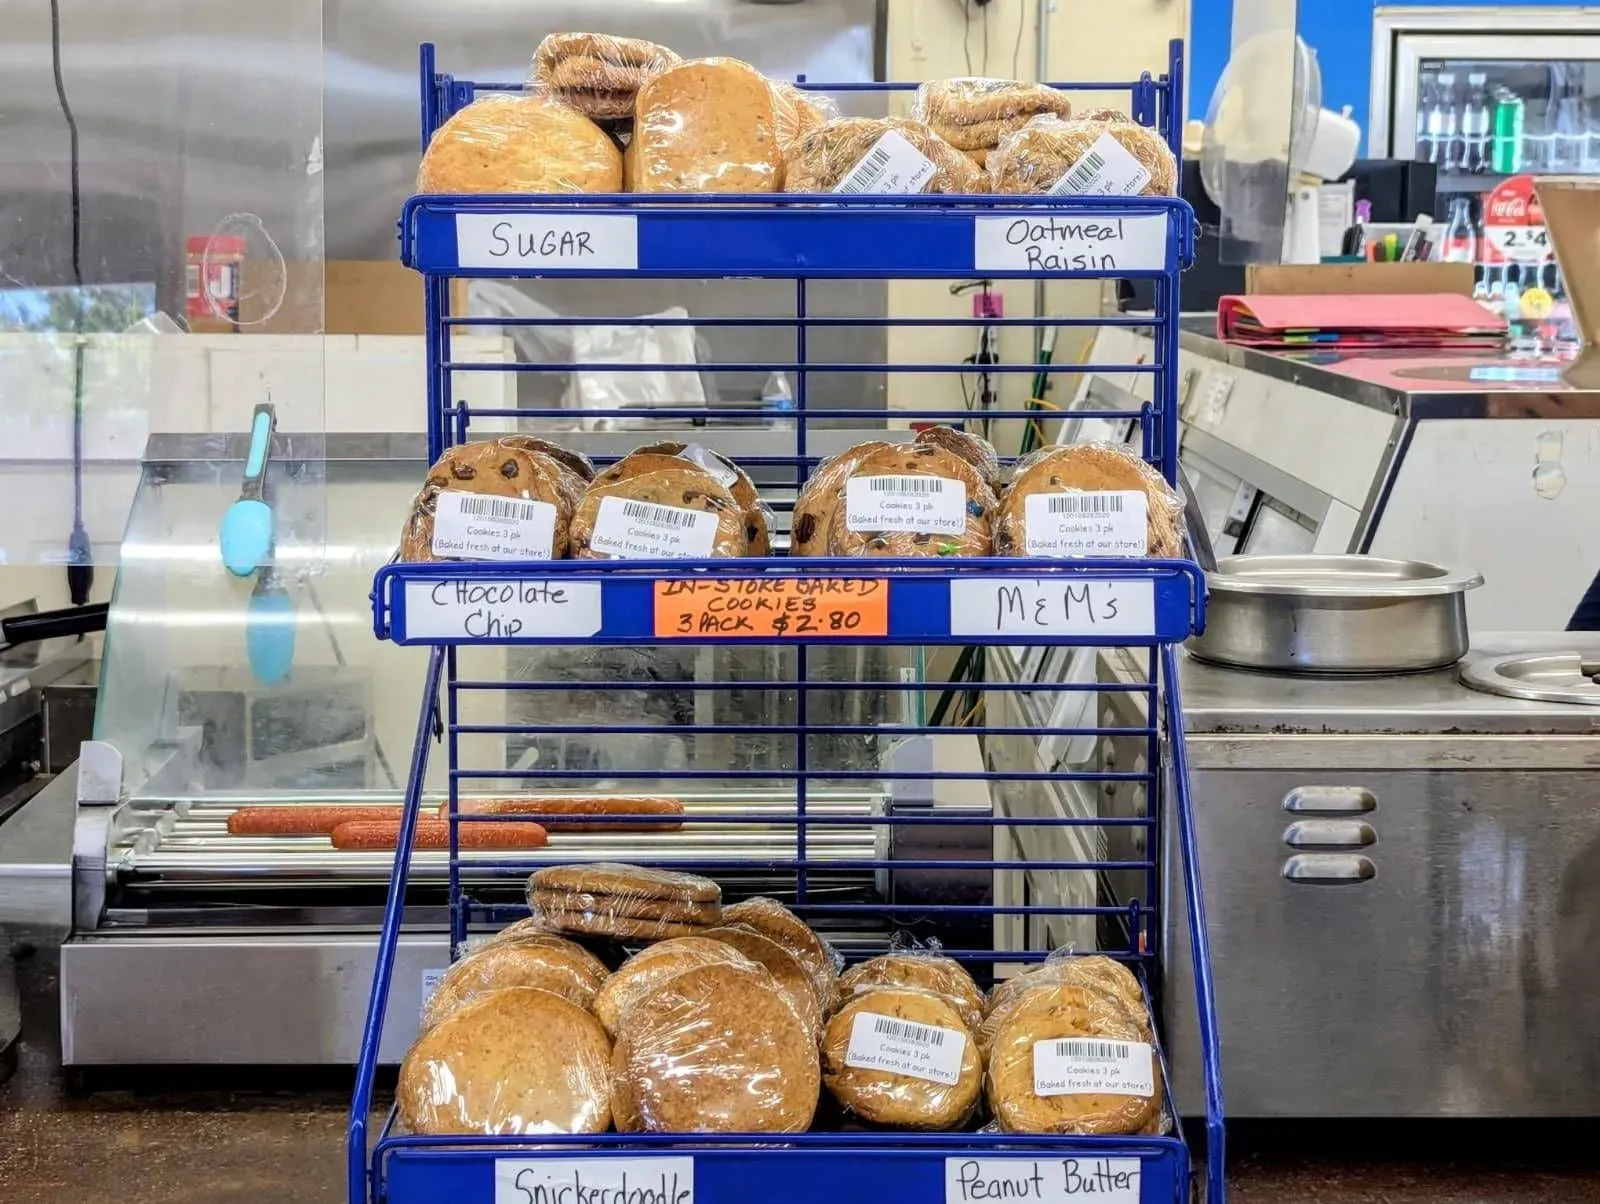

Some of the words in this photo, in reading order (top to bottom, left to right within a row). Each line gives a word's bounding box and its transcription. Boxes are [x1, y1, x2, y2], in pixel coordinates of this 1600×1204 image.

[488, 222, 595, 257] SUGAR
[1006, 218, 1123, 245] Oatmeal
[1503, 231, 1516, 247] 2
[1025, 246, 1116, 271] Raisin
[879, 501, 913, 510] Cookies
[923, 502, 934, 512] pk
[848, 514, 878, 524] (Baked
[880, 515, 904, 524] fresh
[906, 516, 914, 524] at
[934, 517, 964, 527] store!)
[467, 526, 500, 536] Cookies
[510, 529, 521, 540] pk
[627, 528, 660, 540] Cookies
[670, 535, 681, 544] pk
[1059, 524, 1093, 533] Cookies
[1103, 524, 1114, 535] pk
[434, 538, 464, 550] (Baked
[466, 541, 489, 552] fresh
[492, 545, 500, 553] at
[520, 548, 550, 558] store!)
[1028, 540, 1057, 549] (Baked
[1060, 540, 1083, 549] fresh
[1085, 540, 1094, 549] at
[1114, 540, 1145, 550] store!)
[707, 598, 817, 613] COOKIES
[464, 609, 523, 638] Chip
[677, 614, 693, 633] 3
[700, 613, 754, 632] PACK
[772, 611, 861, 635] $2.80
[879, 1043, 911, 1057] Cookies
[920, 1050, 931, 1063] pk
[848, 1051, 875, 1063] (Baked
[878, 1055, 900, 1069] fresh
[901, 1061, 911, 1070] at
[912, 1065, 927, 1074] our
[928, 1067, 958, 1080] store!)
[1066, 1066, 1101, 1075] Cookies
[1110, 1067, 1121, 1077] pk
[1036, 1079, 1066, 1089] (Baked
[1068, 1079, 1091, 1088] fresh
[1093, 1080, 1102, 1088] at
[1121, 1081, 1152, 1091] store!)
[956, 1160, 1044, 1200] Peanut
[1062, 1158, 1140, 1194] Butter
